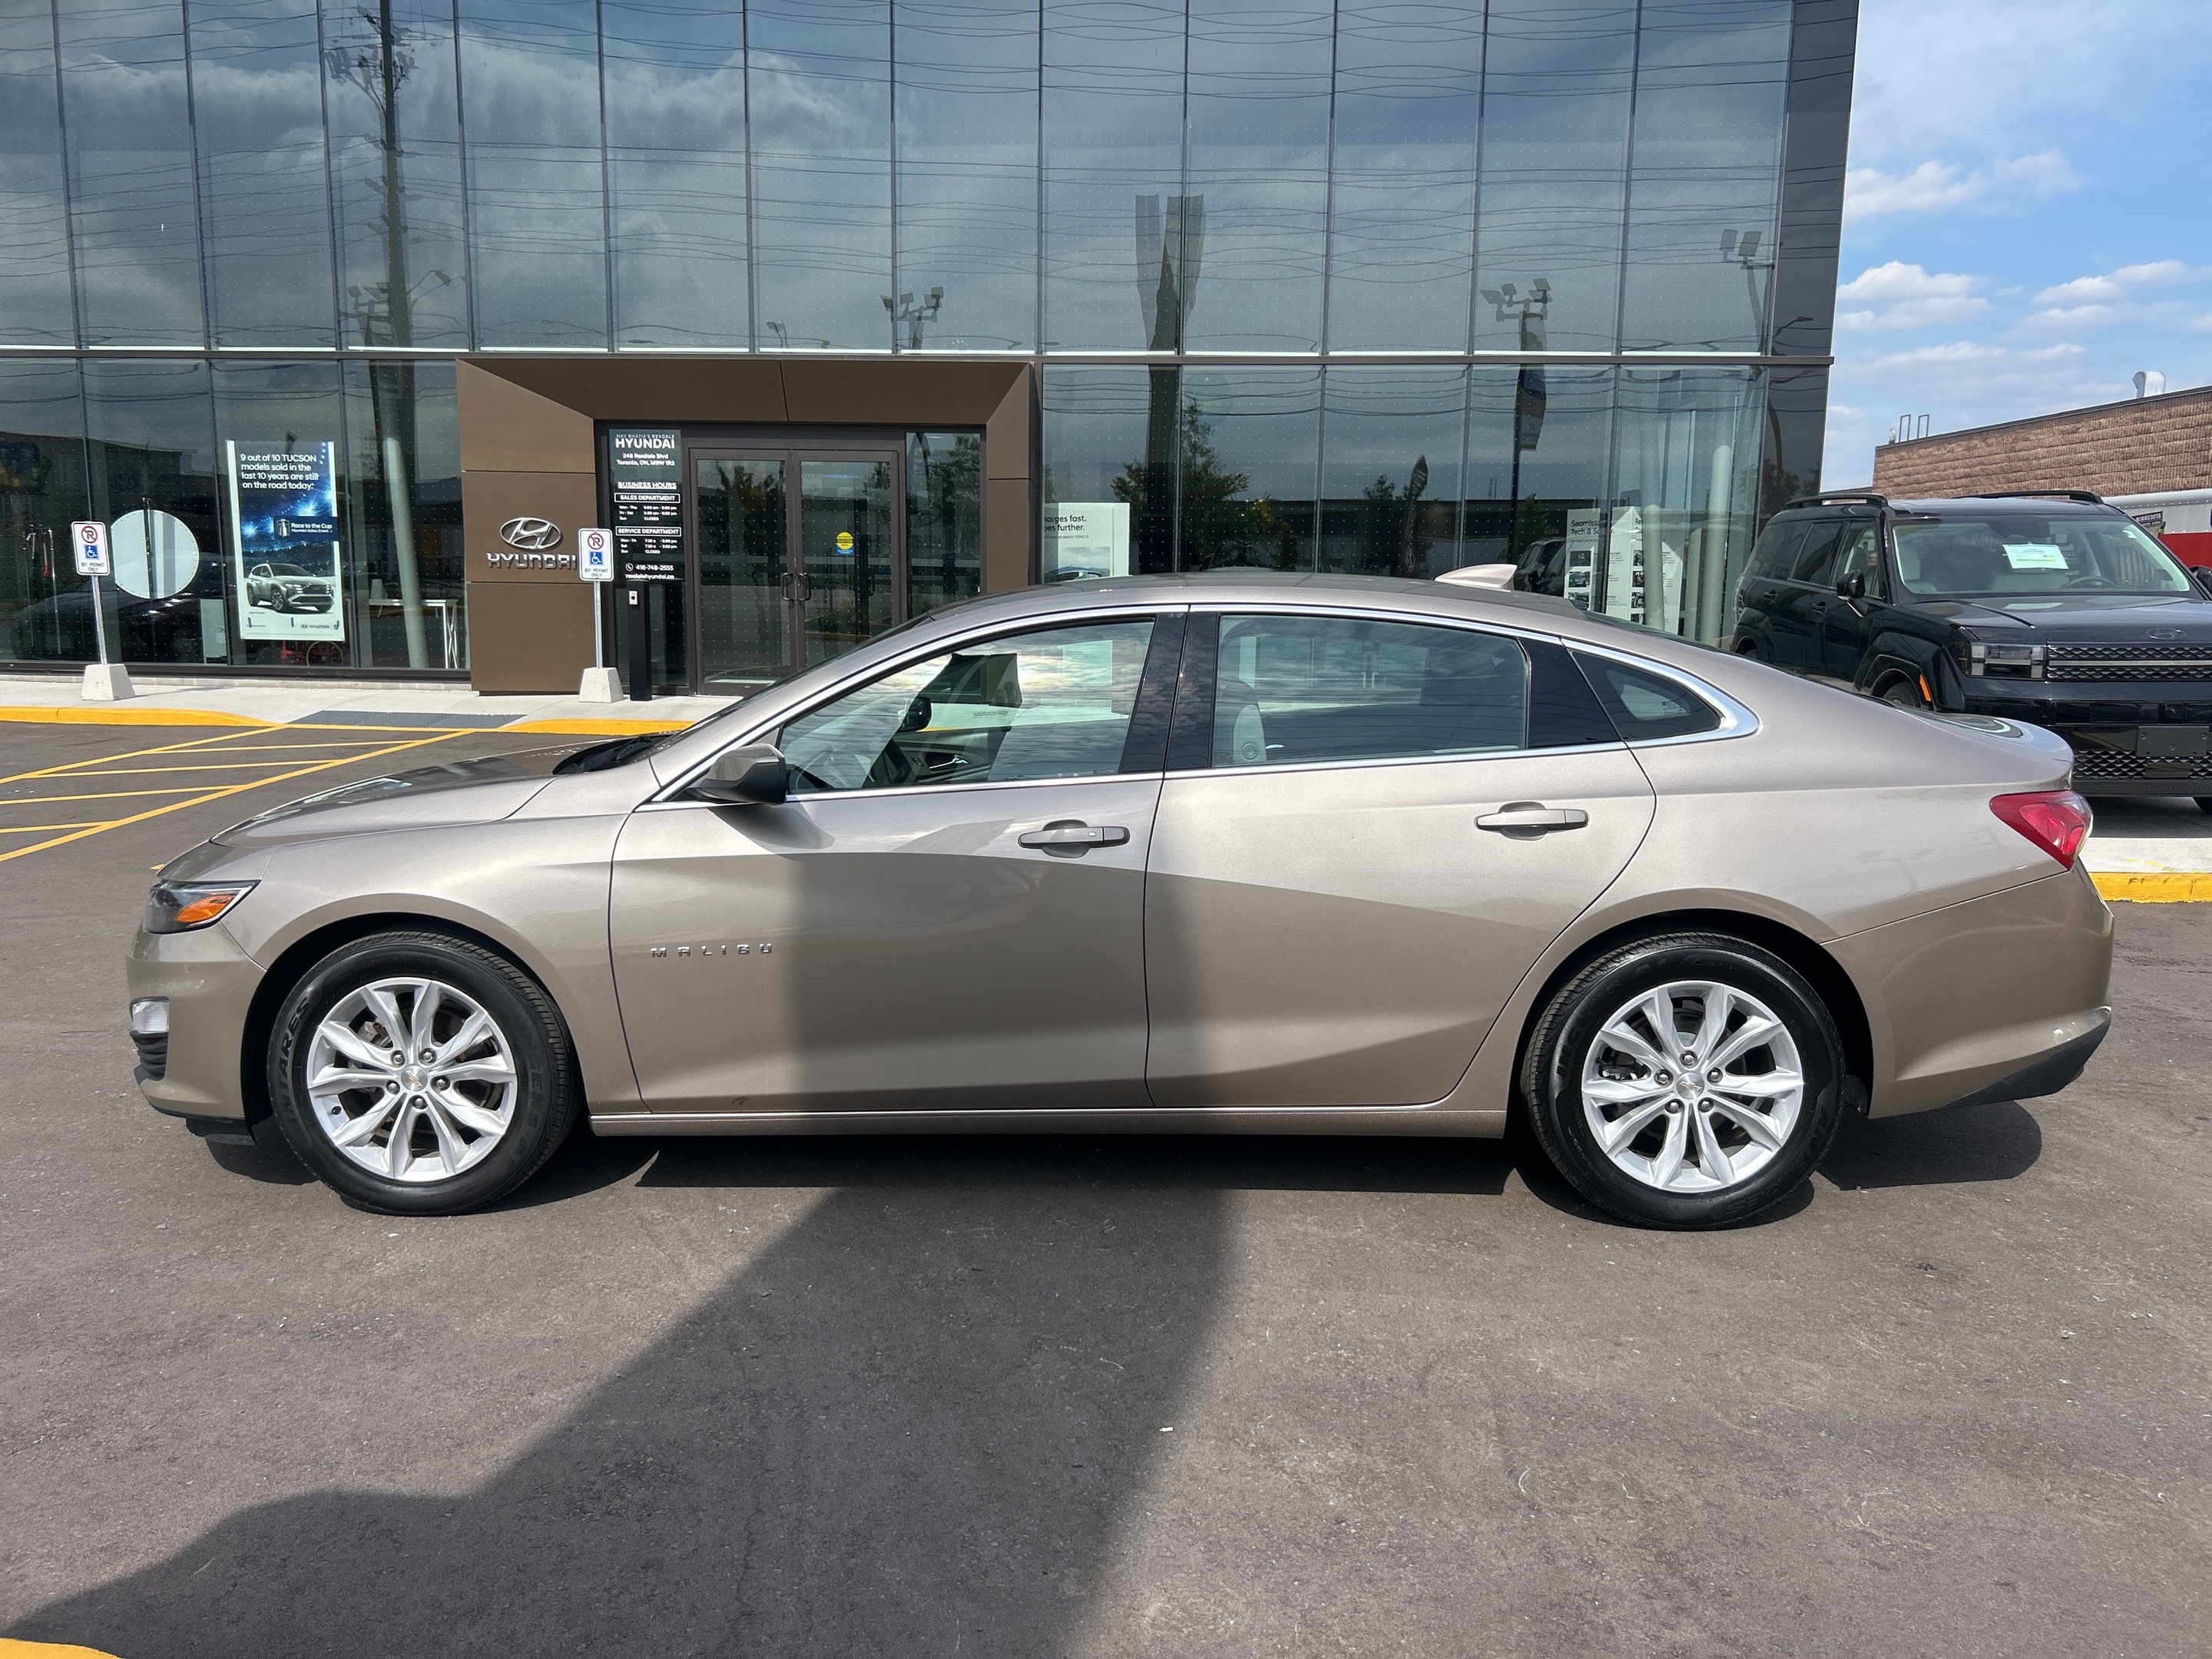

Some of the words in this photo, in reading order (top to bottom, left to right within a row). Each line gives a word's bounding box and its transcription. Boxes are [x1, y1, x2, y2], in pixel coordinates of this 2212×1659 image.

[616, 438, 674, 449] HYUNDAI
[486, 552, 576, 569] HYUNDAI
[651, 943, 773, 958] MALIBU
[279, 997, 310, 1128] ANTARES
